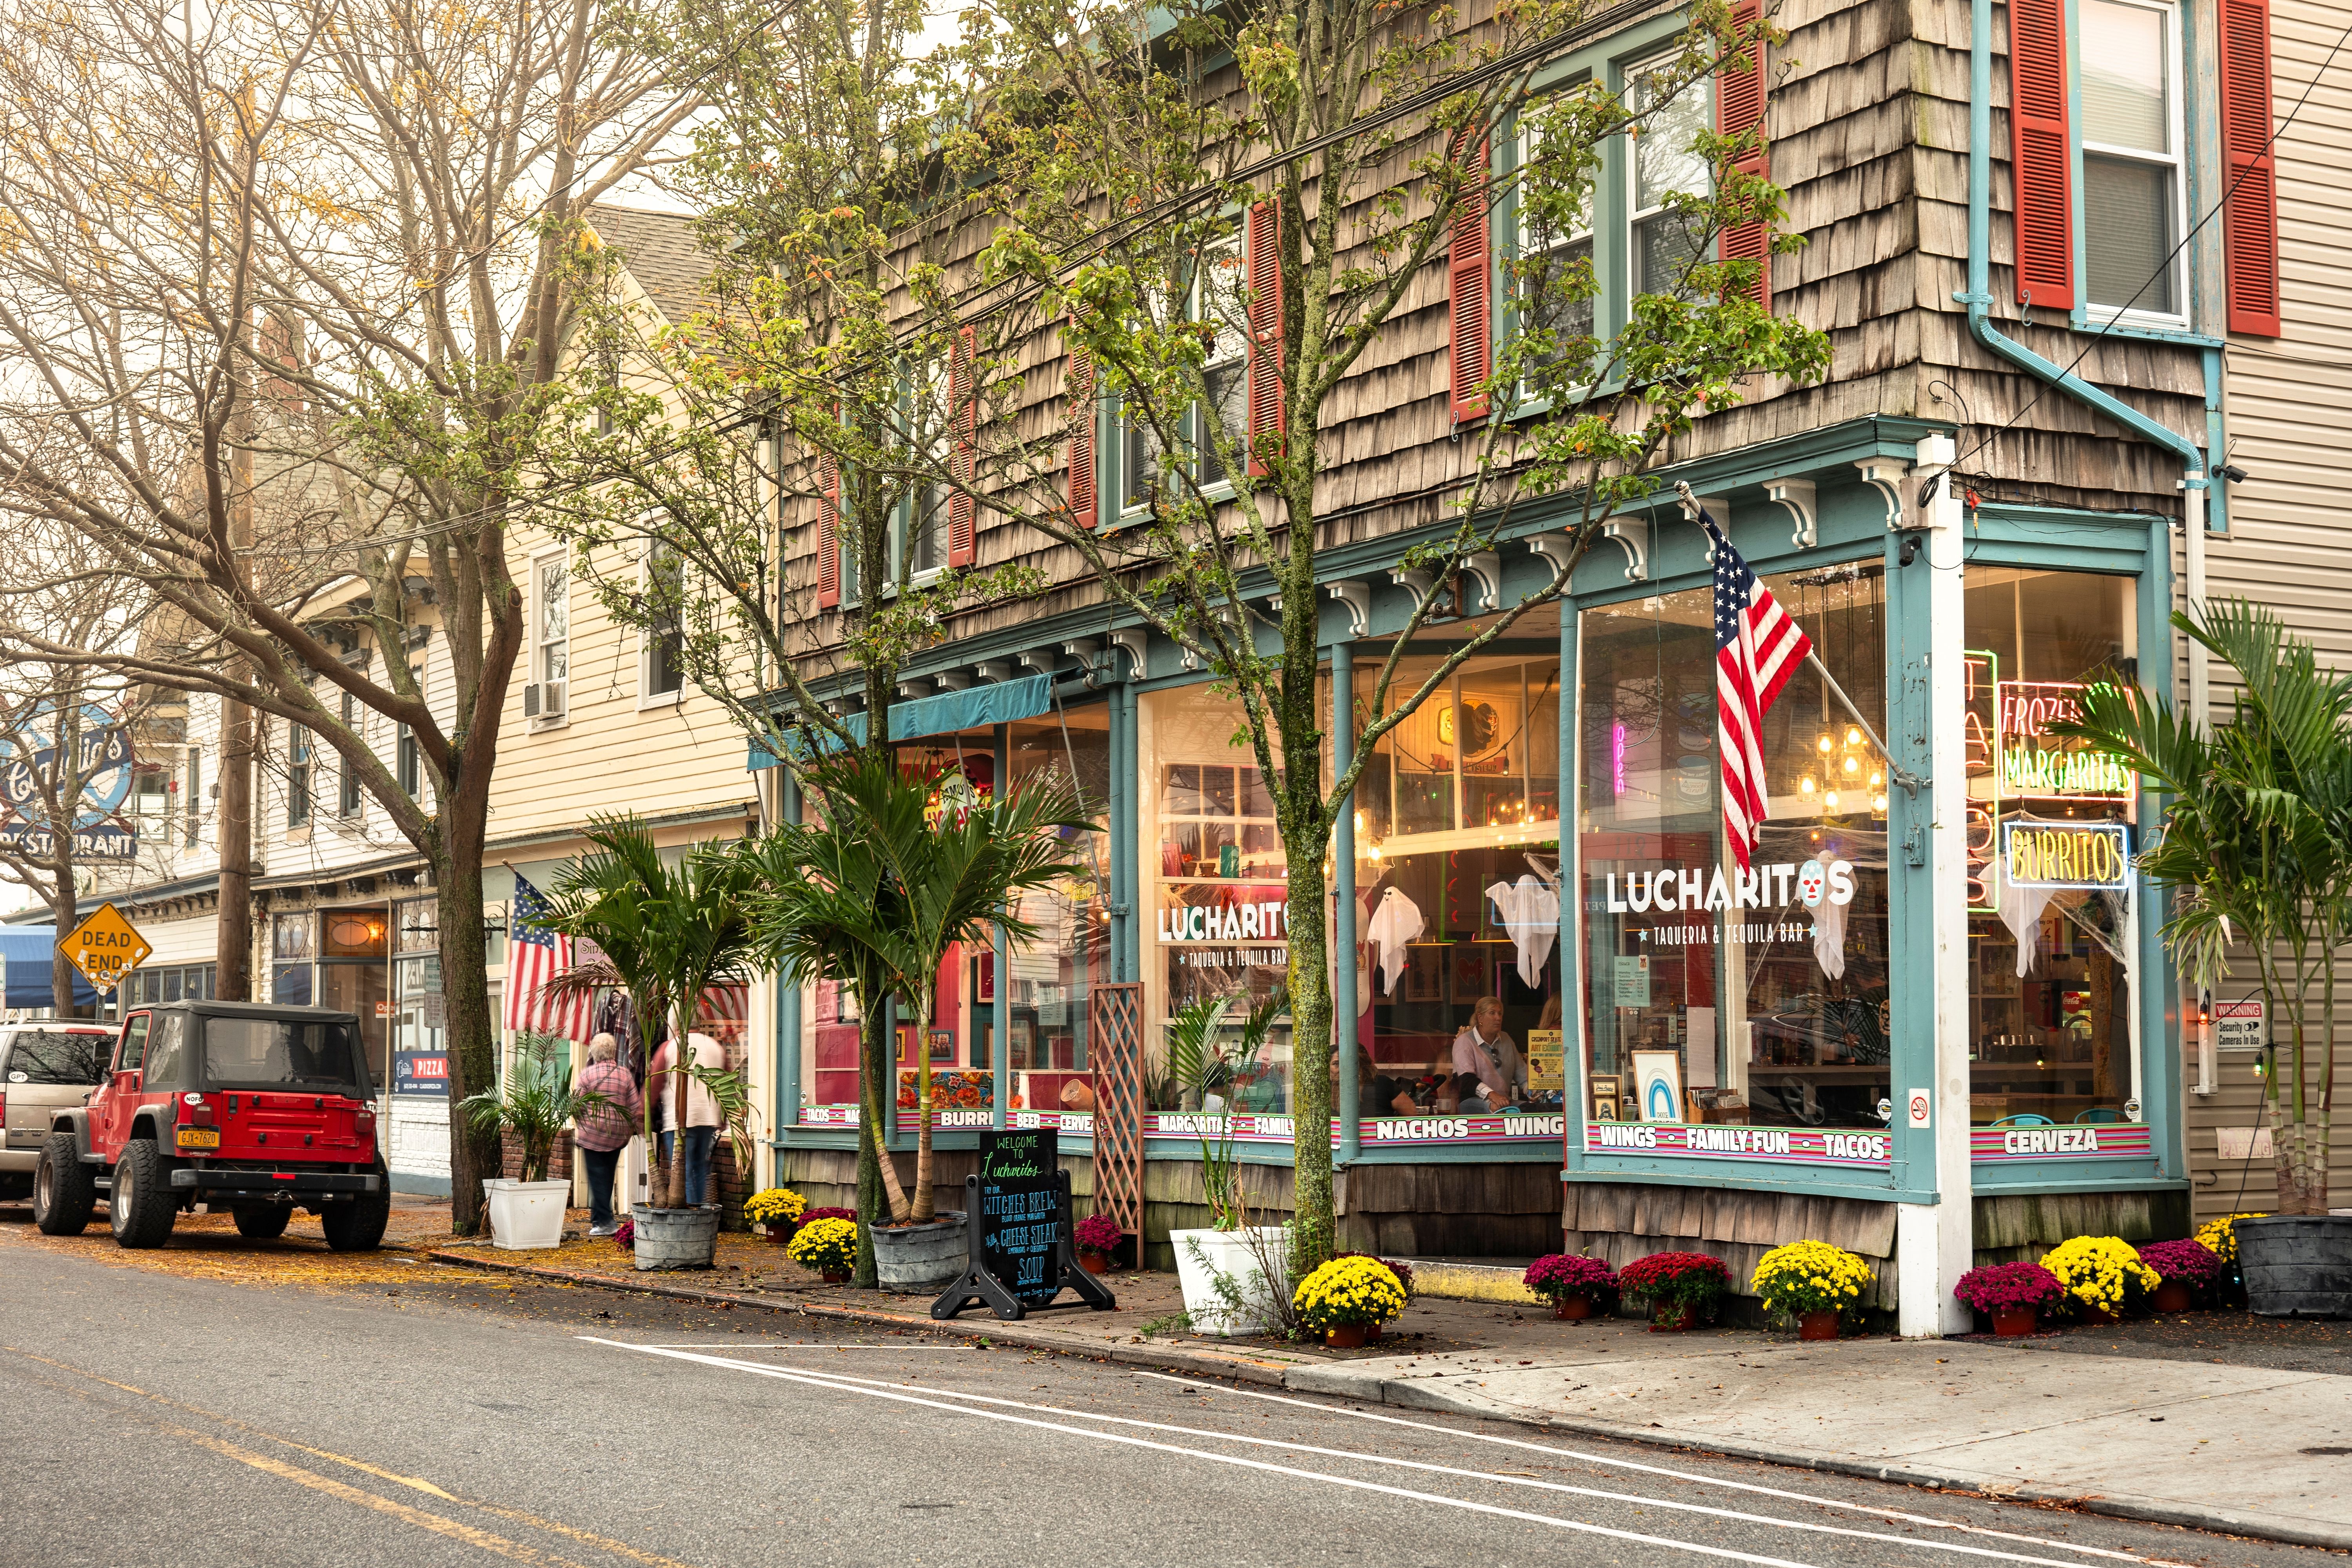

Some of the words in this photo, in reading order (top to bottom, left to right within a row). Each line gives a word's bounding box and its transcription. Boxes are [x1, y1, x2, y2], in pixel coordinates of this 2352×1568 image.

[7, 731, 122, 802] Clauio's
[2003, 749, 2132, 792] MARGARITAS
[1, 832, 132, 856] RESTRANT
[2012, 829, 2125, 882] BURRITOS
[83, 931, 131, 947] DEAD
[1654, 925, 1707, 946] TAQUERIA
[1713, 924, 1720, 944] &
[1725, 923, 1774, 944] TEQUILA
[1780, 922, 1803, 942] BAR
[87, 954, 123, 970] END
[1189, 951, 1224, 967] TAQUERIA
[1228, 951, 1232, 966] &
[1236, 949, 1267, 966] TEQUILA
[1272, 948, 1287, 964] BAR
[377, 1003, 395, 1012] Ope
[2217, 1005, 2259, 1016] WARNING
[2219, 1021, 2243, 1034] Security
[2219, 1034, 2242, 1045] Cameras
[2243, 1034, 2249, 1045] In
[2250, 1034, 2259, 1045] Use
[418, 1060, 443, 1076] PIZZA
[806, 1107, 829, 1123] TACOS
[1017, 1112, 1040, 1129] BEER
[1158, 1114, 1232, 1134] MARGARITAS
[181, 1132, 194, 1143] GJX
[199, 1133, 216, 1144] 7620
[1376, 1118, 1469, 1140] NACHOS
[2234, 1129, 2253, 1142] NO
[997, 1135, 1038, 1149] WELCOME
[1599, 1124, 1657, 1149] WINGS
[1686, 1127, 1749, 1153] FAMILY
[1751, 1130, 1790, 1154] FUN
[1822, 1134, 1885, 1160] TACOS
[2004, 1127, 2099, 1154] CERVEZA
[2222, 1142, 2270, 1156] PARKING
[1013, 1149, 1023, 1159] TO
[982, 1152, 1043, 1185] Lucharitos
[984, 1194, 1025, 1214] WITCHES
[1029, 1190, 1057, 1212] BREW
[1001, 1227, 1029, 1247] CHEESE
[1030, 1222, 1058, 1245] STEAK
[1017, 1256, 1044, 1280] SOUP
